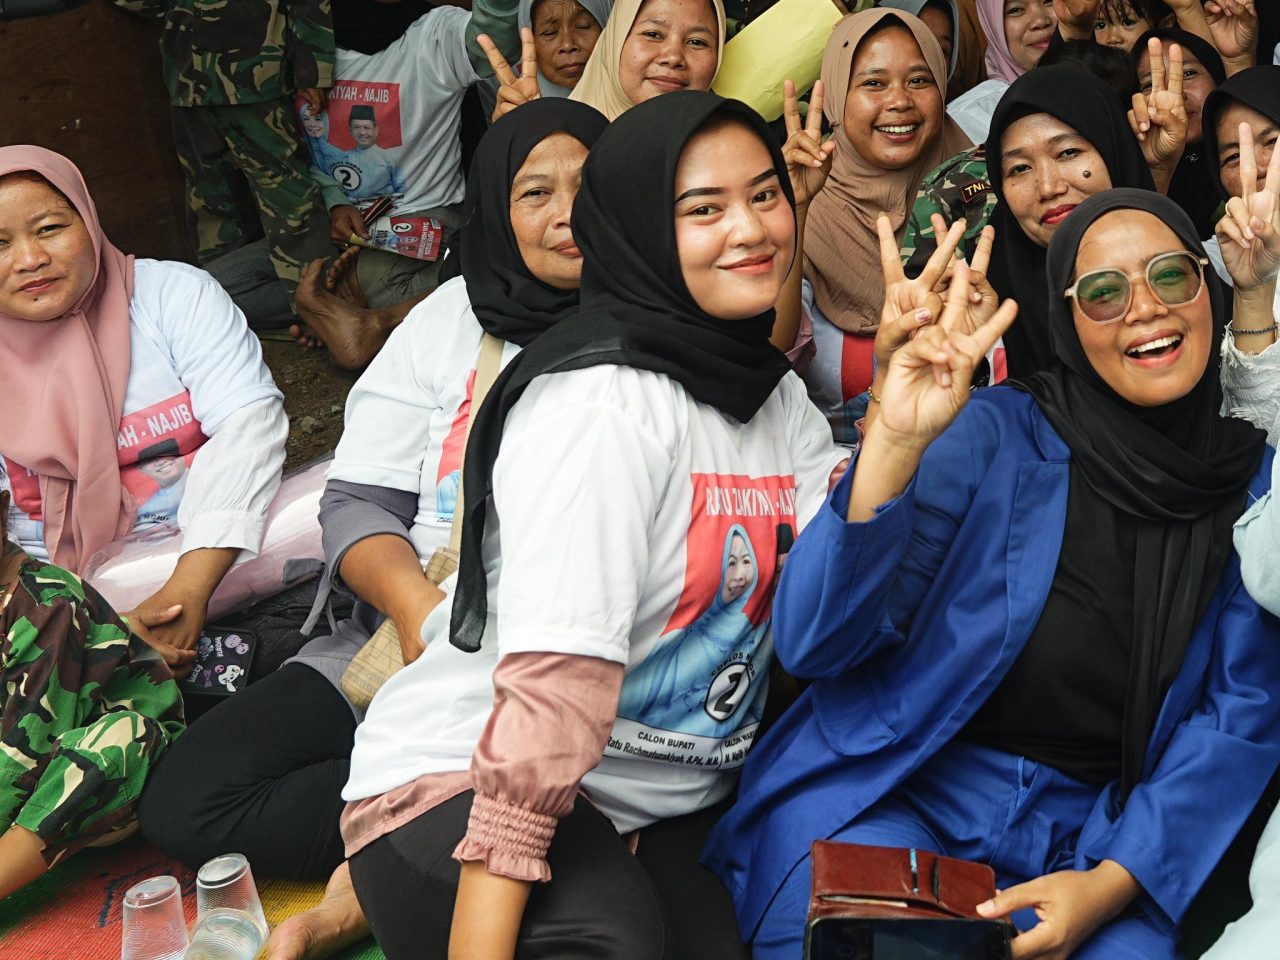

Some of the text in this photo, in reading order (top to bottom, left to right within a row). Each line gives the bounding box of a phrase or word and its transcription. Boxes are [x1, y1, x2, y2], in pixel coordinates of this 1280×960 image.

[364, 87, 389, 103] NAJIB
[339, 169, 352, 188] 2
[147, 403, 192, 438] NAJIB
[713, 671, 743, 714] 2
[637, 731, 666, 745] CALON
[668, 738, 696, 751] BUPATI
